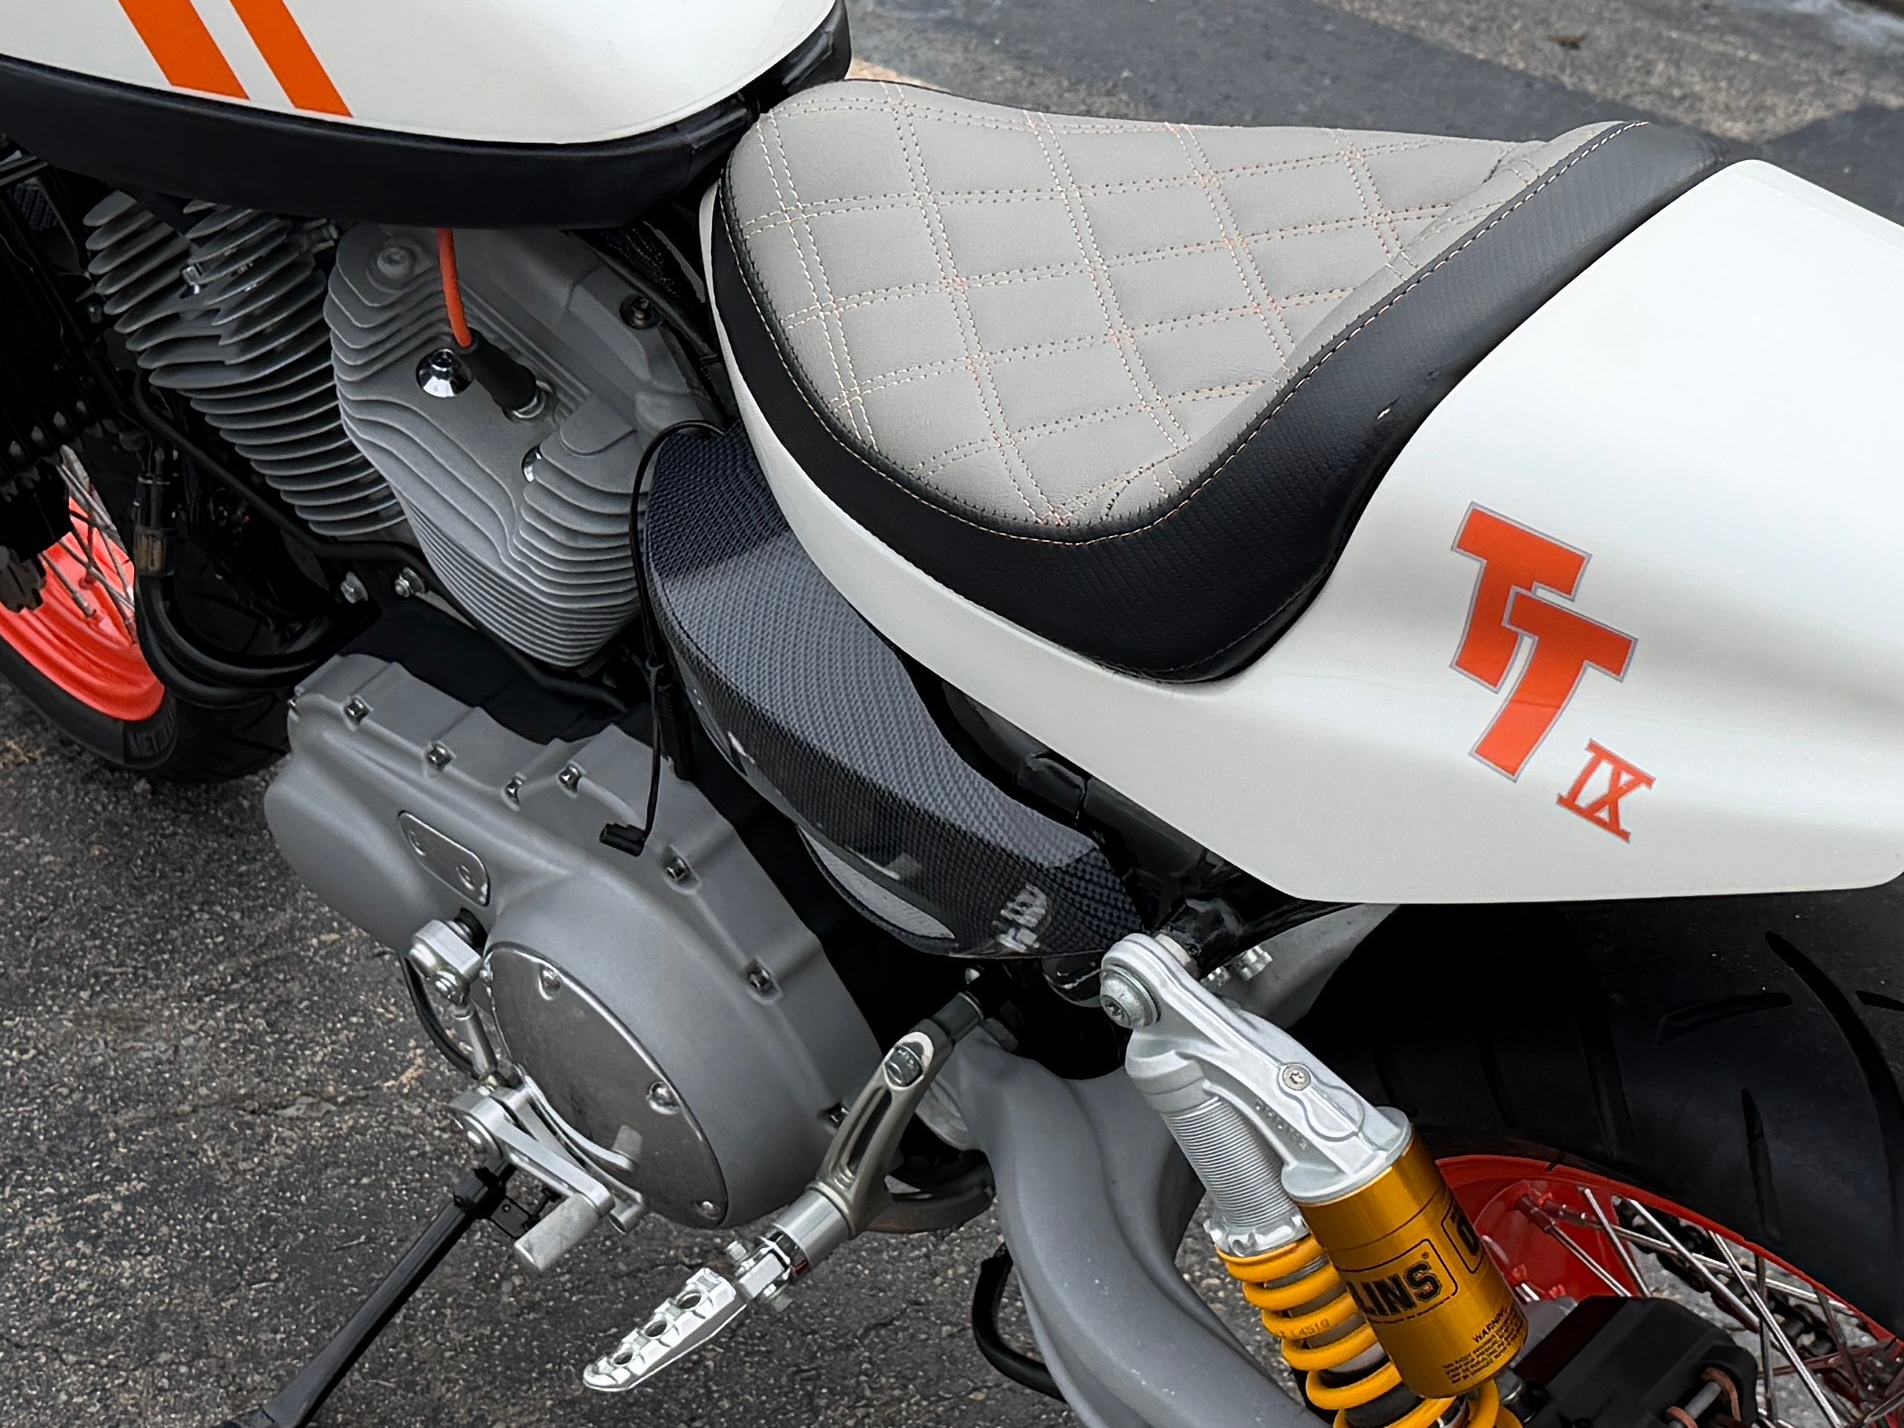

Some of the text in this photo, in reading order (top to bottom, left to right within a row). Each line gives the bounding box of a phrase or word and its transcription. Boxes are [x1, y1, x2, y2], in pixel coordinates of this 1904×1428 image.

[1449, 500, 1657, 845] TT IX
[1347, 1260, 1443, 1317] LINS
